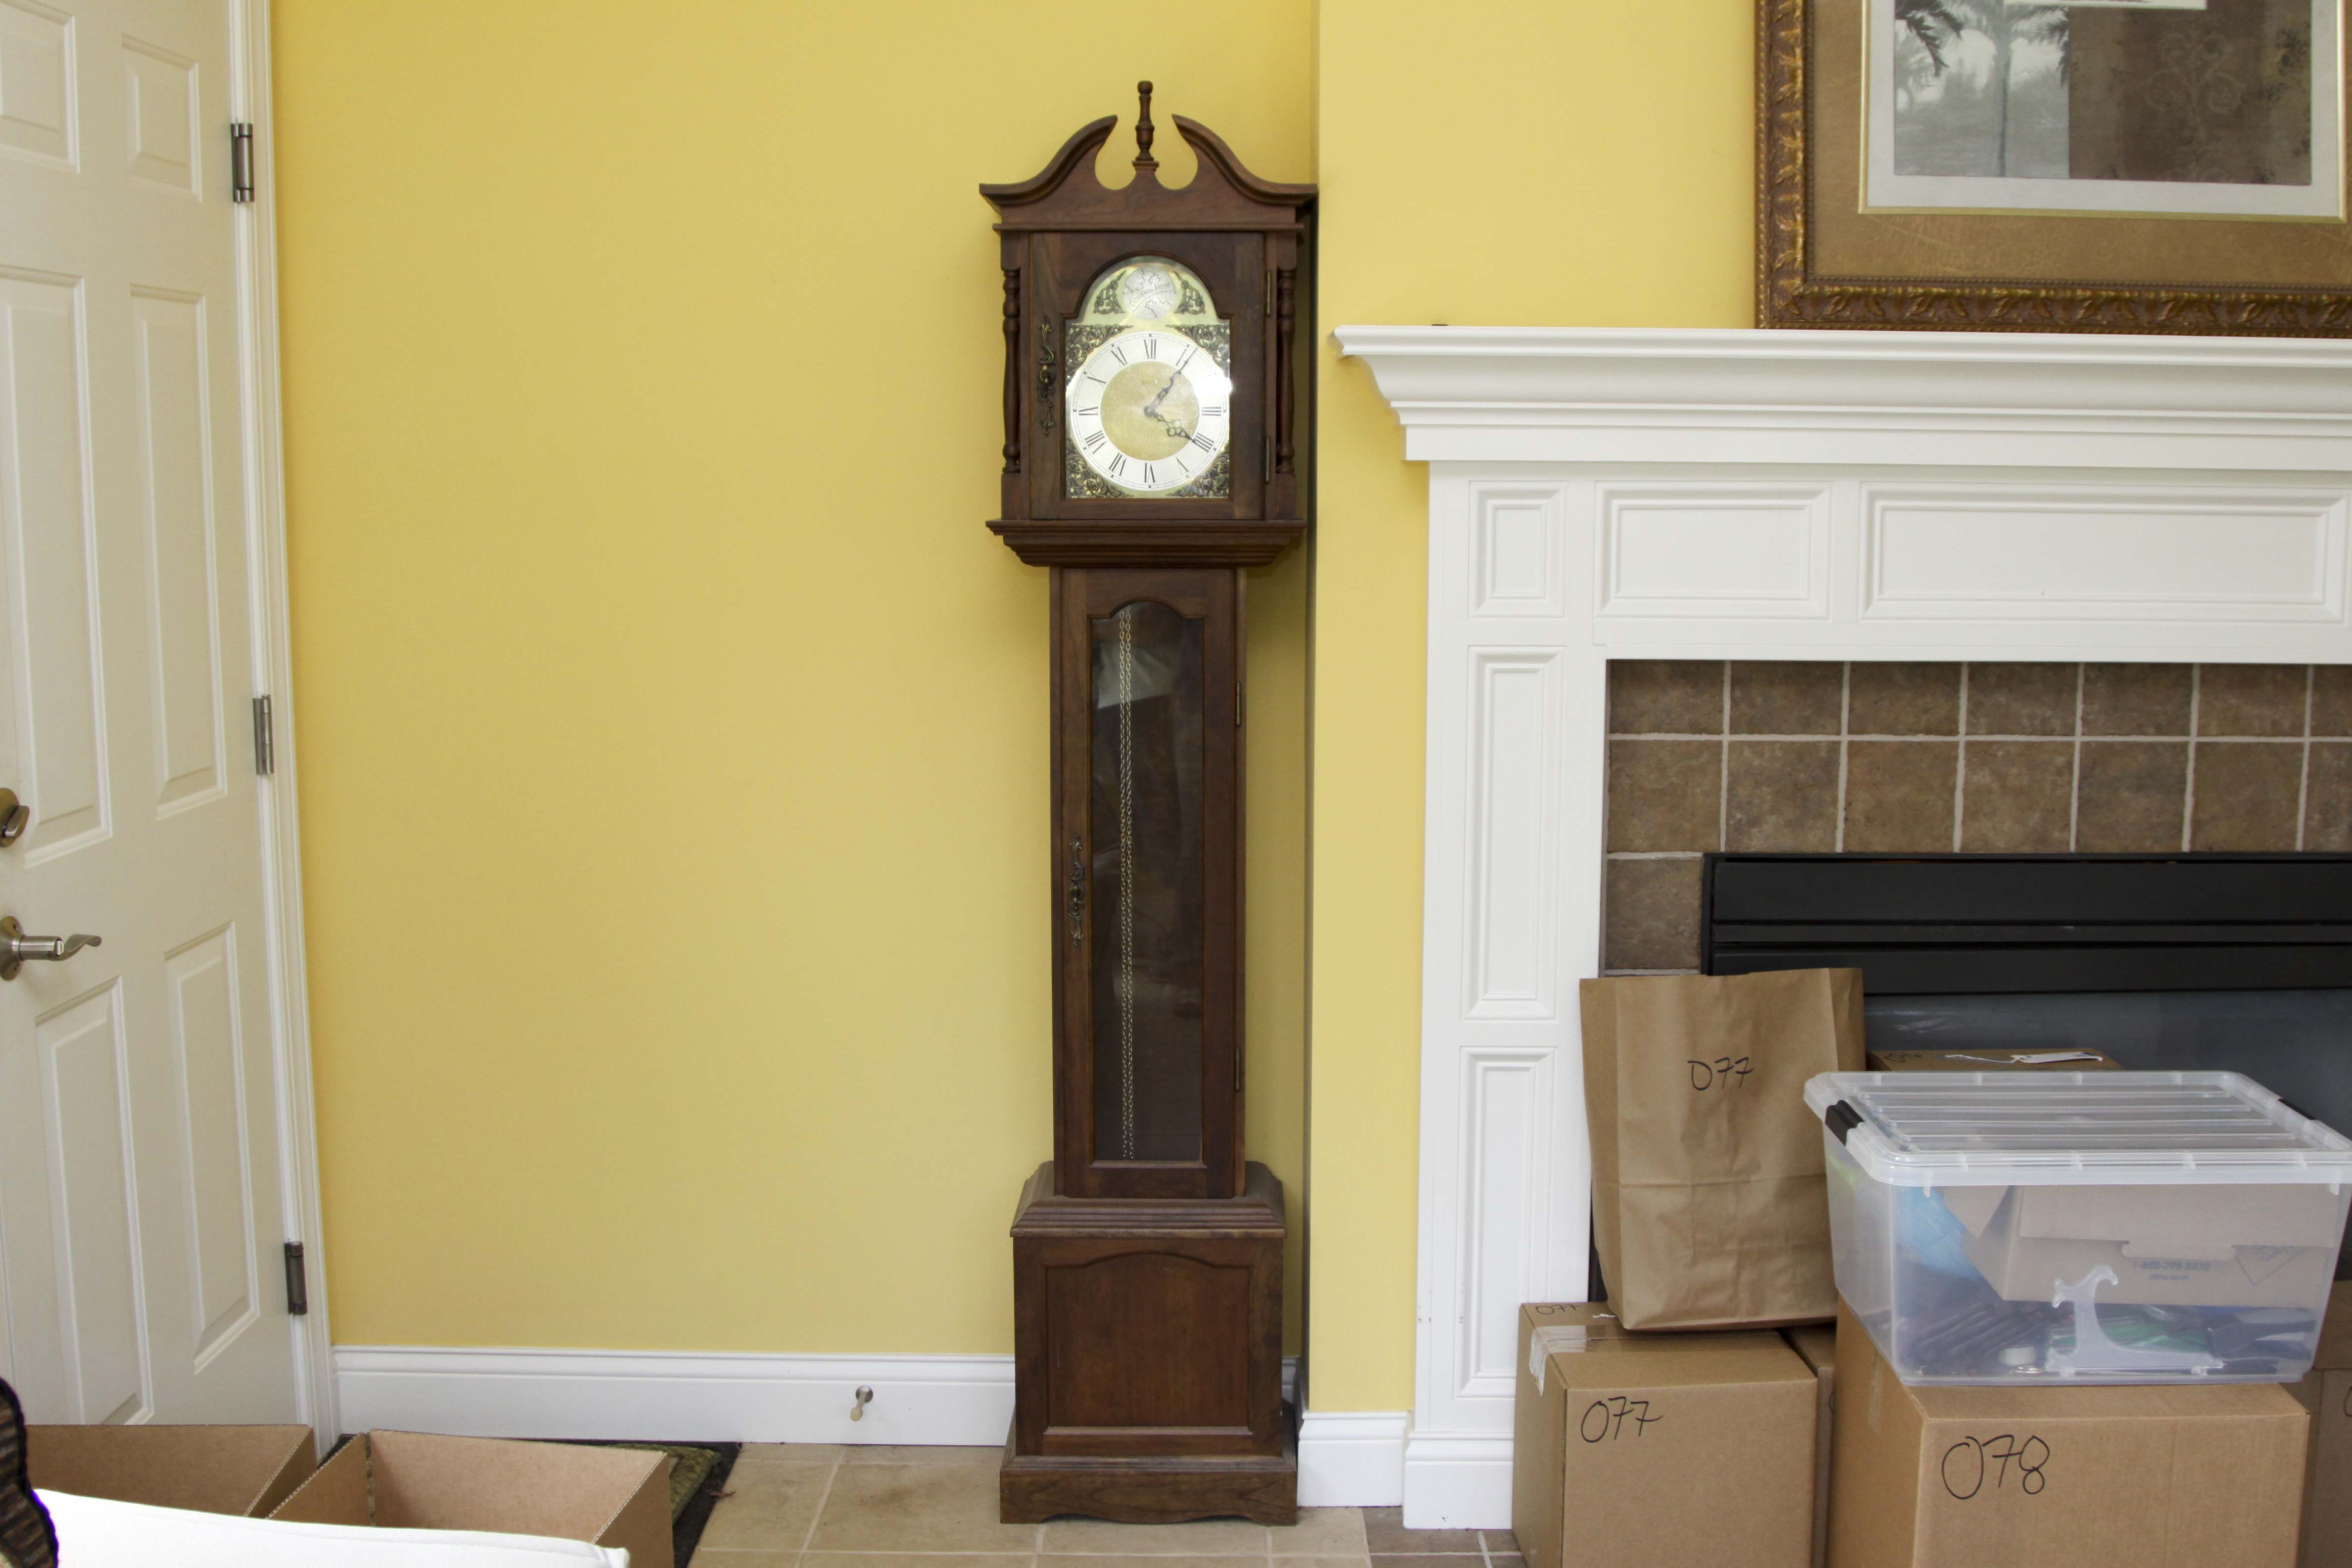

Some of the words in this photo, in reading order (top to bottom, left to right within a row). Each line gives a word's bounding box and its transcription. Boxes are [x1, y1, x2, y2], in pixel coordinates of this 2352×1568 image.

[1110, 346, 1128, 368] XI
[1143, 338, 1156, 360] XII
[1086, 371, 1107, 388] X
[1078, 404, 1099, 416] IX
[1201, 406, 1222, 416] III
[1083, 430, 1108, 455] VIII
[1108, 452, 1127, 477] VII
[1144, 462, 1156, 484] VI
[1176, 456, 1189, 476] V
[1687, 1056, 1755, 1091] 077
[1535, 1303, 1581, 1315] 077
[1581, 1395, 1664, 1443] 077
[1941, 1434, 2050, 1500] 078
